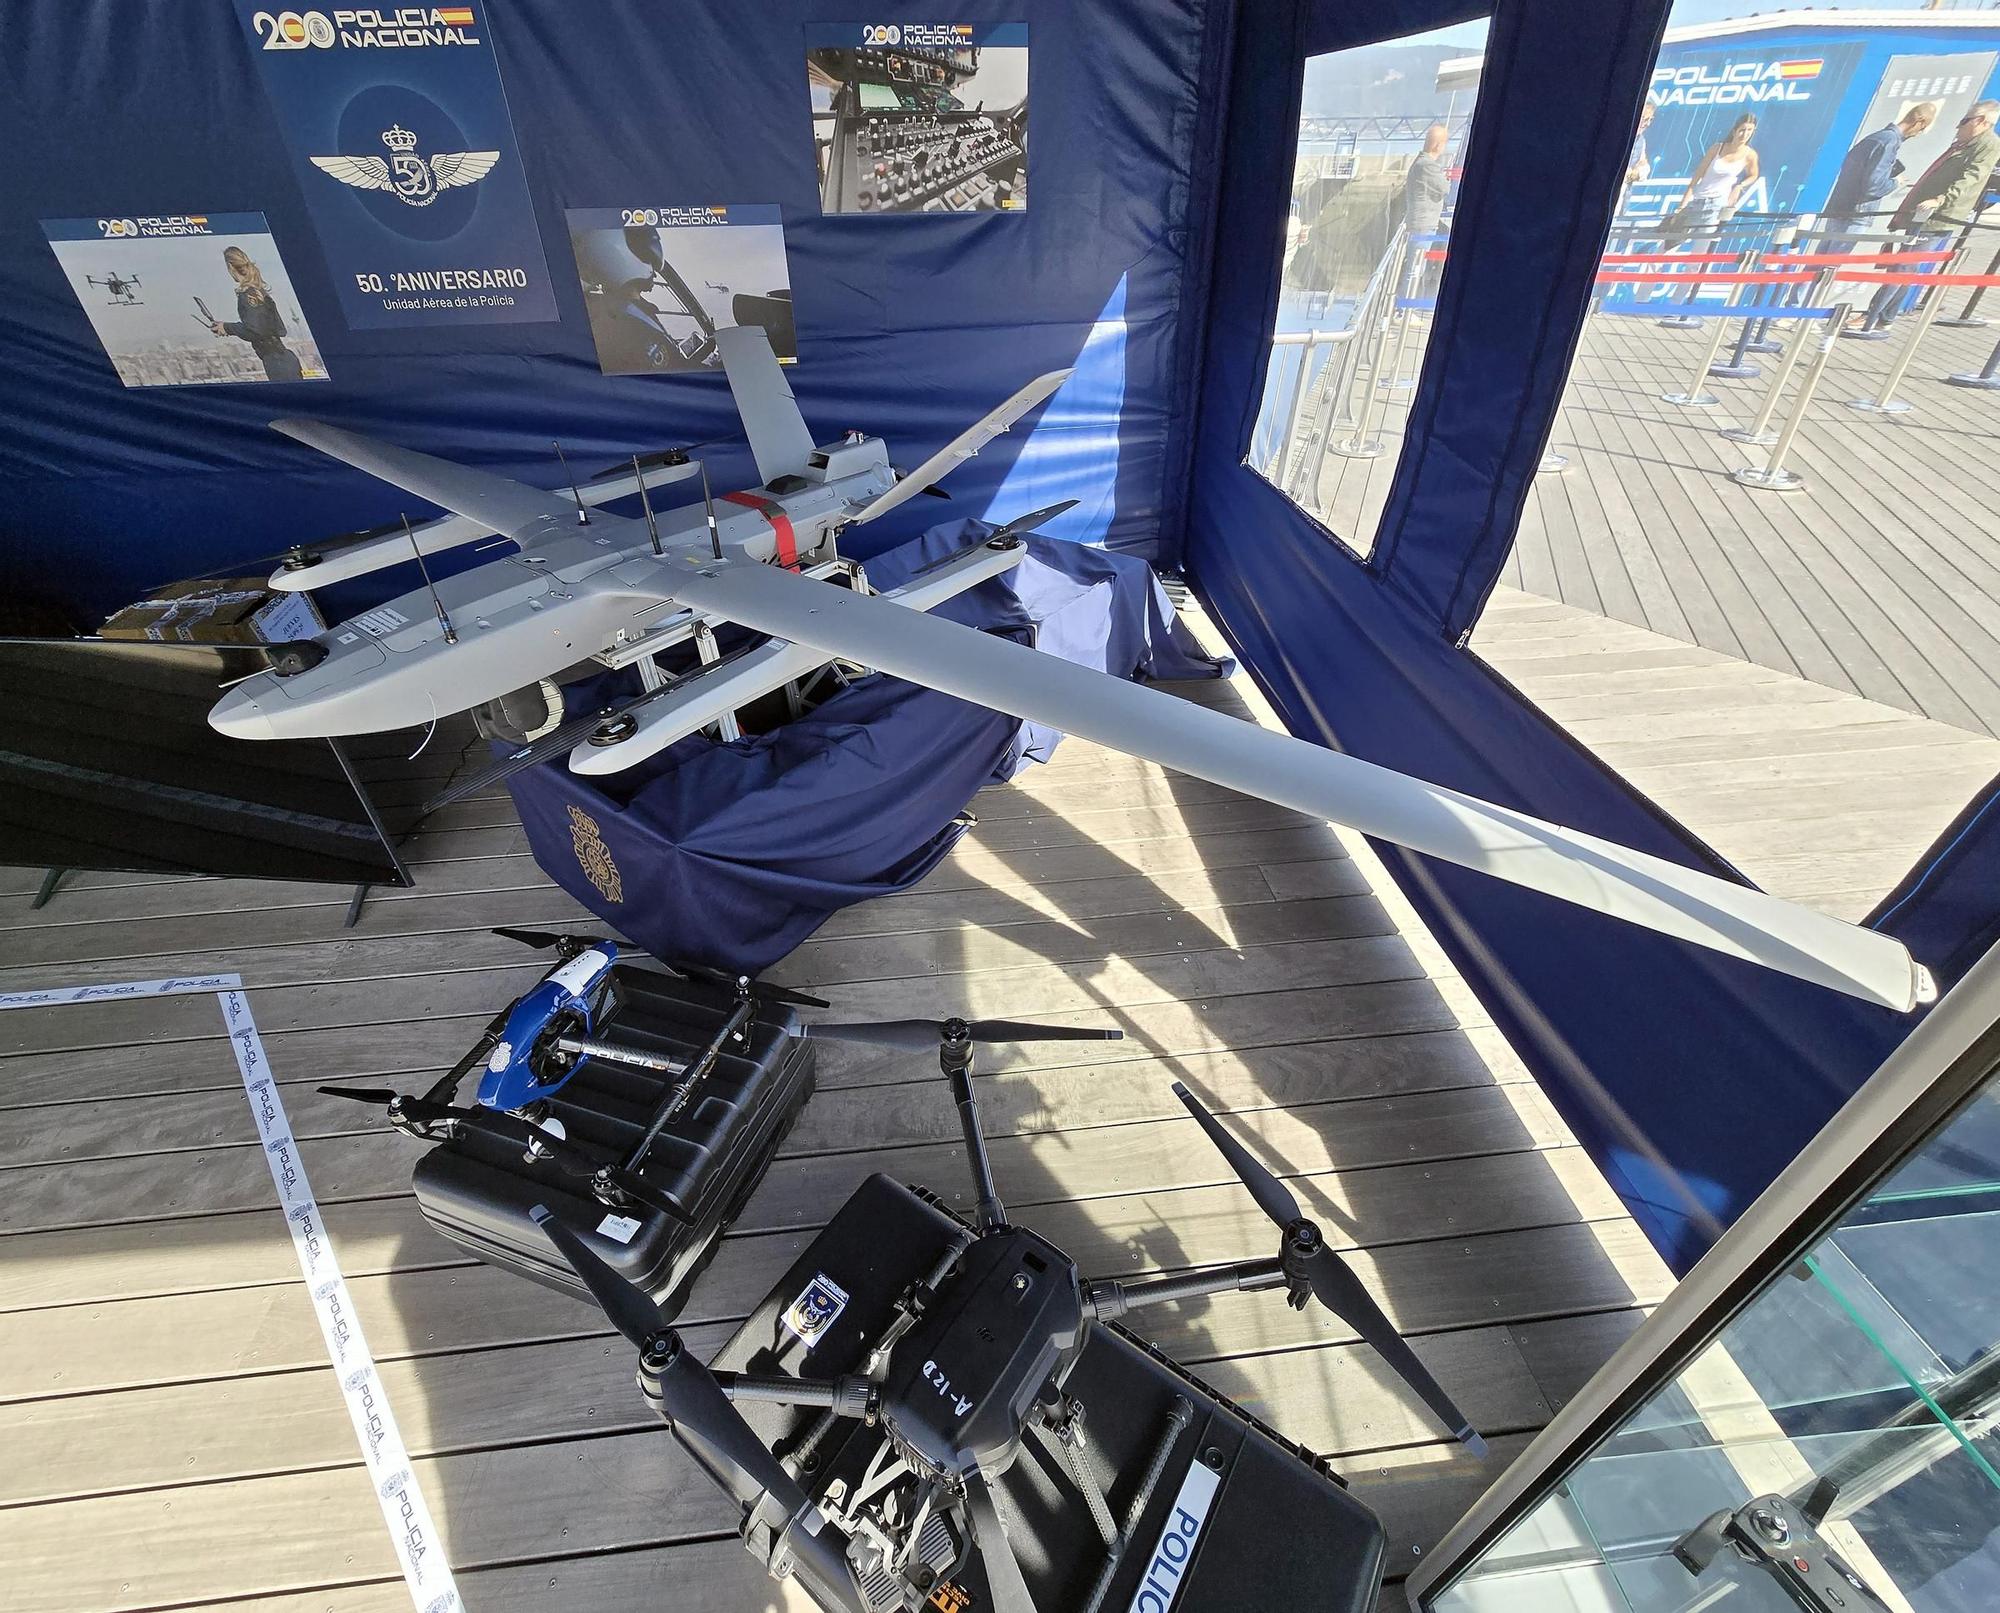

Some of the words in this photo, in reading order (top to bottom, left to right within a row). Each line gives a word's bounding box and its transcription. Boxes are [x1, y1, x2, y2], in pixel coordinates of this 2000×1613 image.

[333, 8, 448, 28] POLICIA
[253, 11, 336, 50] 200
[341, 28, 480, 48] NACIONAL
[863, 25, 901, 45] 200
[903, 25, 958, 35] POLICIA
[904, 35, 973, 45] NACIONAL
[1648, 82, 1811, 106] NACIONAL
[137, 216, 193, 227] POLICIA
[621, 209, 658, 227] 200
[660, 207, 713, 217] POLICIA
[661, 216, 729, 226] NACIONAL
[98, 219, 138, 238] 200
[141, 225, 213, 236] NACIONAL
[383, 298, 421, 310] Unidad
[423, 296, 453, 309] Aérea
[454, 296, 467, 308] de
[469, 295, 479, 307] la
[480, 294, 515, 307] Policía
[228, 991, 242, 1016] OLICIA
[242, 1034, 258, 1066] POLICIA
[582, 1047, 654, 1068] POLICIA
[260, 1087, 276, 1123] POLICIA
[279, 1147, 297, 1188] POLICIA
[300, 1215, 321, 1258] POLICIA
[328, 1293, 350, 1344] POLICIA
[923, 1360, 974, 1416] A-12D
[358, 1383, 385, 1443] POLICIA
[395, 1489, 427, 1560] POLICIA
